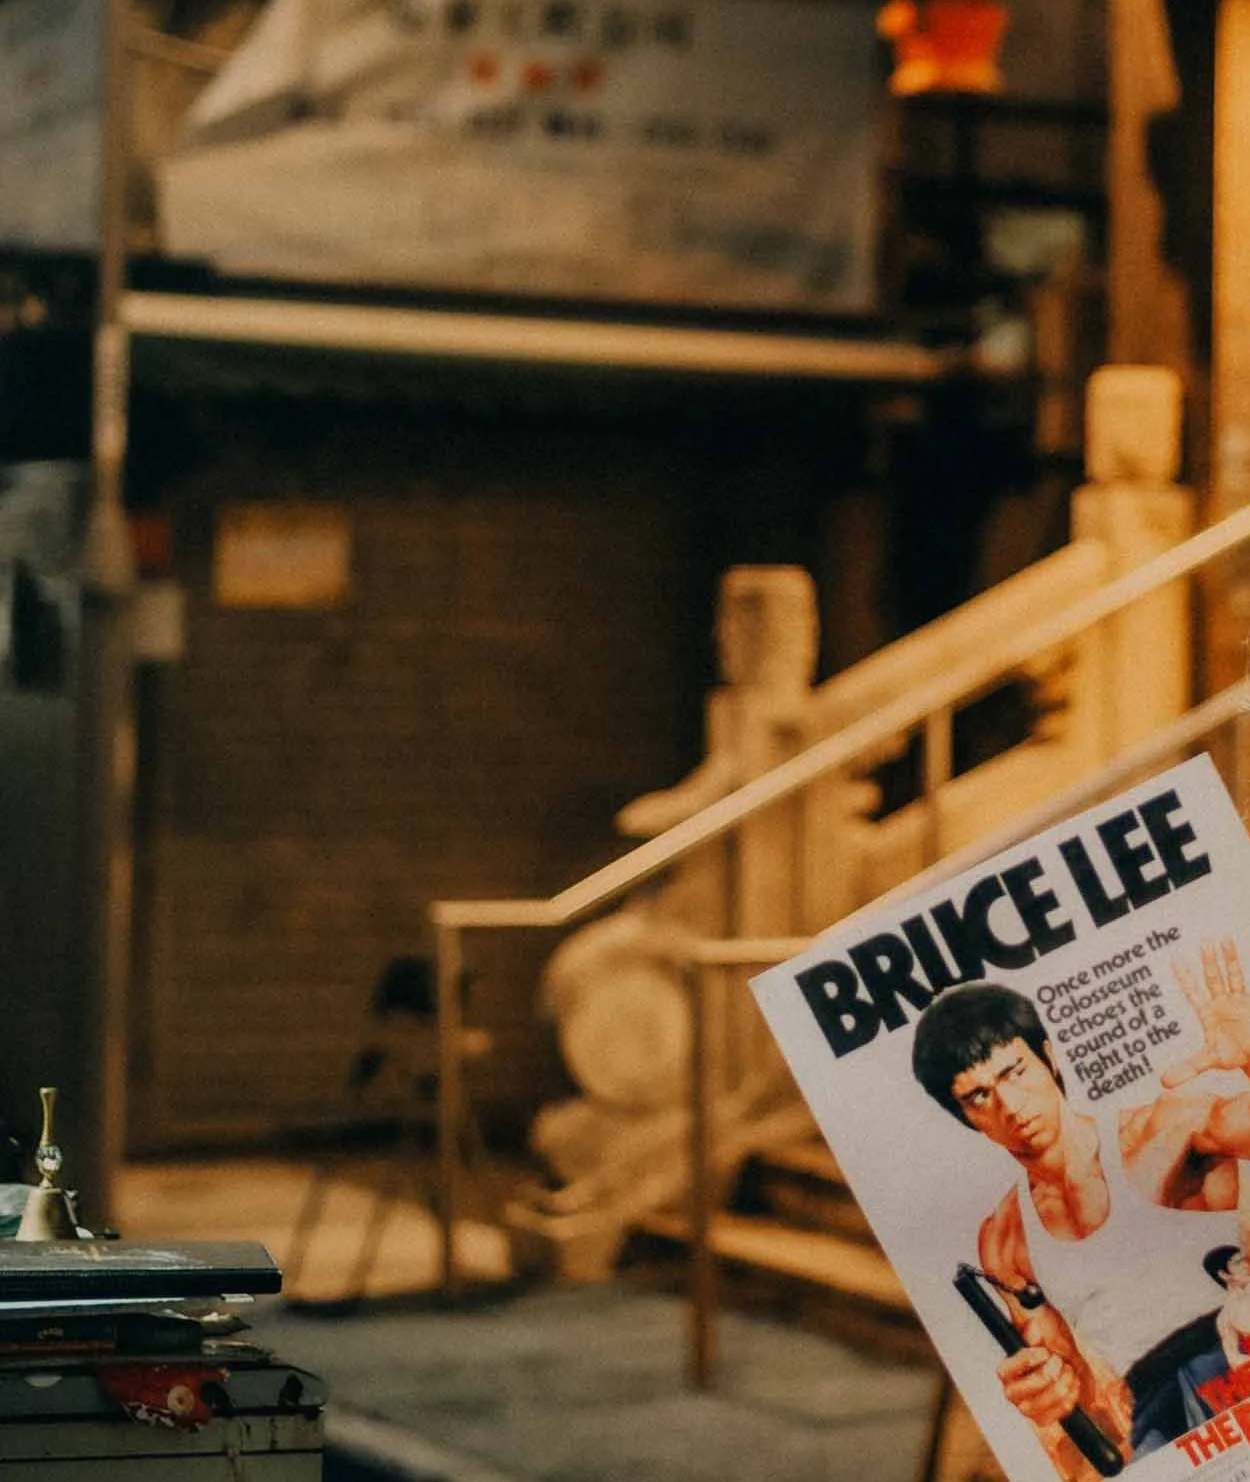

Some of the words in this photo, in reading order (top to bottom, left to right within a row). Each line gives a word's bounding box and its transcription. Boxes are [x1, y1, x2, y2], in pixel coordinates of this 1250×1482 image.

[794, 855, 1077, 1059] BRUCE
[1057, 789, 1212, 929] LEE
[1036, 969, 1091, 1005] Once
[1092, 944, 1146, 980] more
[1146, 926, 1181, 951] the
[1046, 965, 1152, 1024] Colosseum
[1057, 1001, 1127, 1044] echoes
[1128, 983, 1163, 1008] the
[1066, 1021, 1128, 1063] sound
[1128, 1008, 1149, 1032] of
[1152, 1004, 1167, 1020] a
[1074, 1048, 1124, 1083] fight
[1123, 1039, 1147, 1058] to
[1146, 1020, 1182, 1046] the
[1087, 1054, 1154, 1101] death!
[1175, 1418, 1242, 1468] THE
